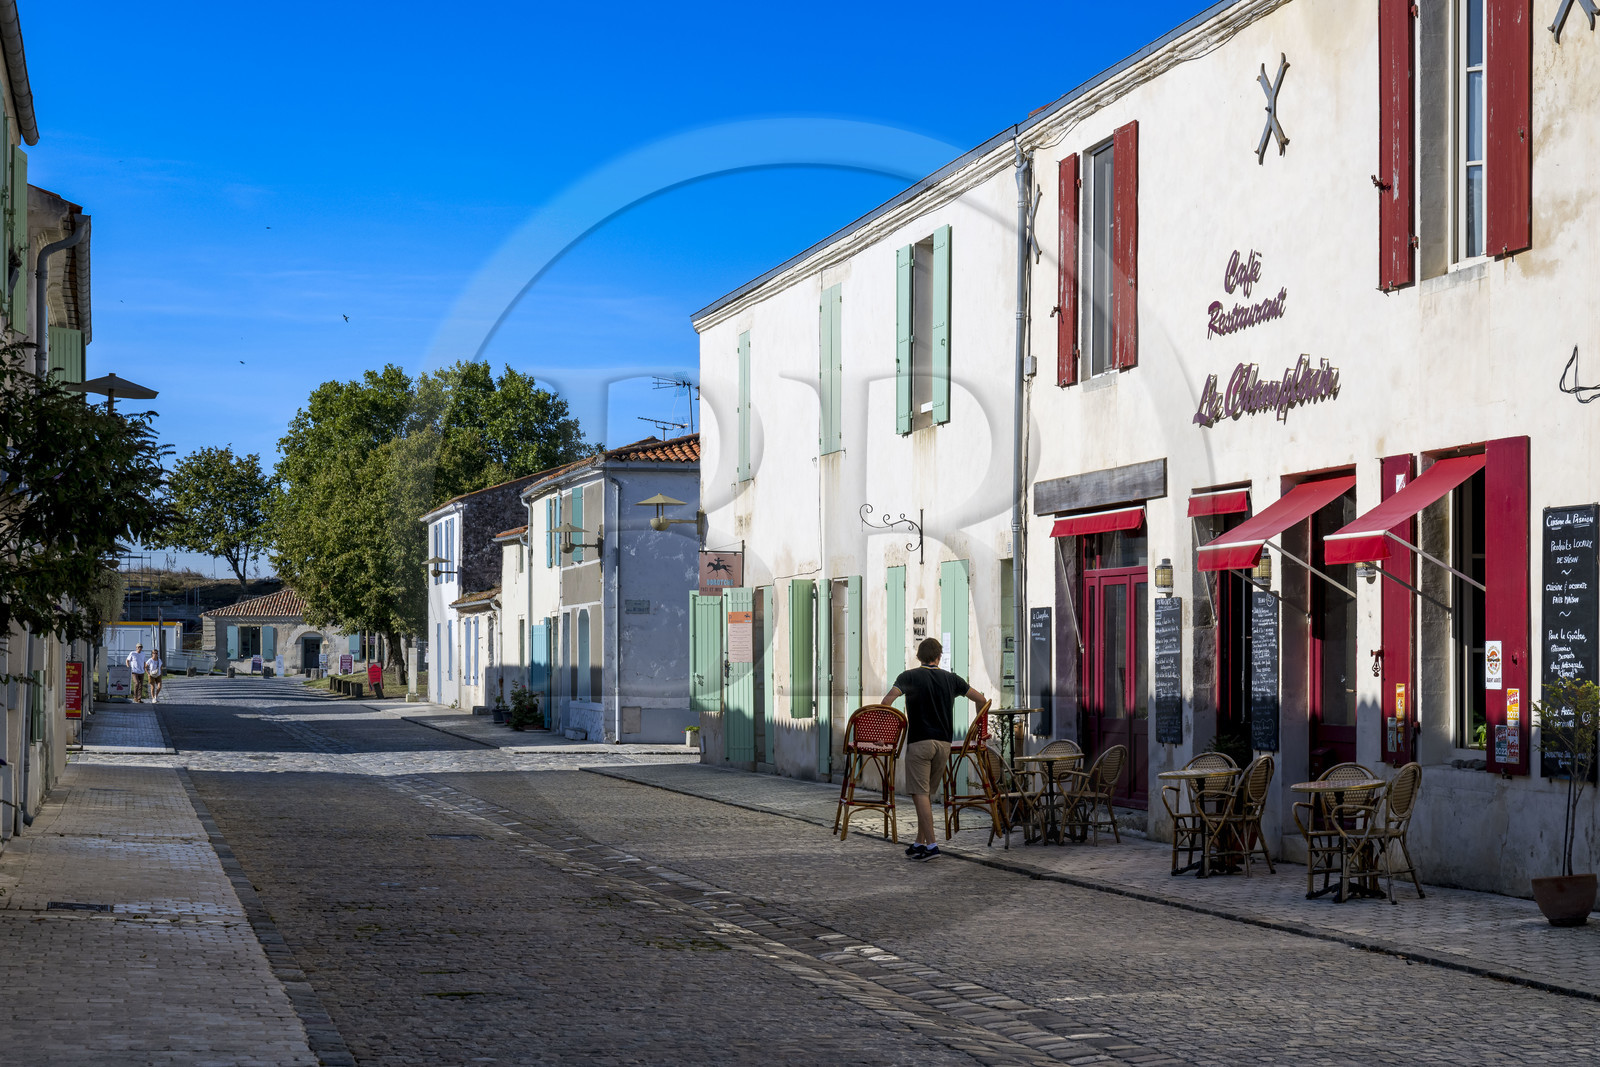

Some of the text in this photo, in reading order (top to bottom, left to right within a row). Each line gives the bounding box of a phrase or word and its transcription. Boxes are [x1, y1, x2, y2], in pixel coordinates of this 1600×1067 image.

[1224, 249, 1262, 298] Café
[1207, 286, 1287, 340] Restaurant
[1551, 540, 1572, 552] Produits
